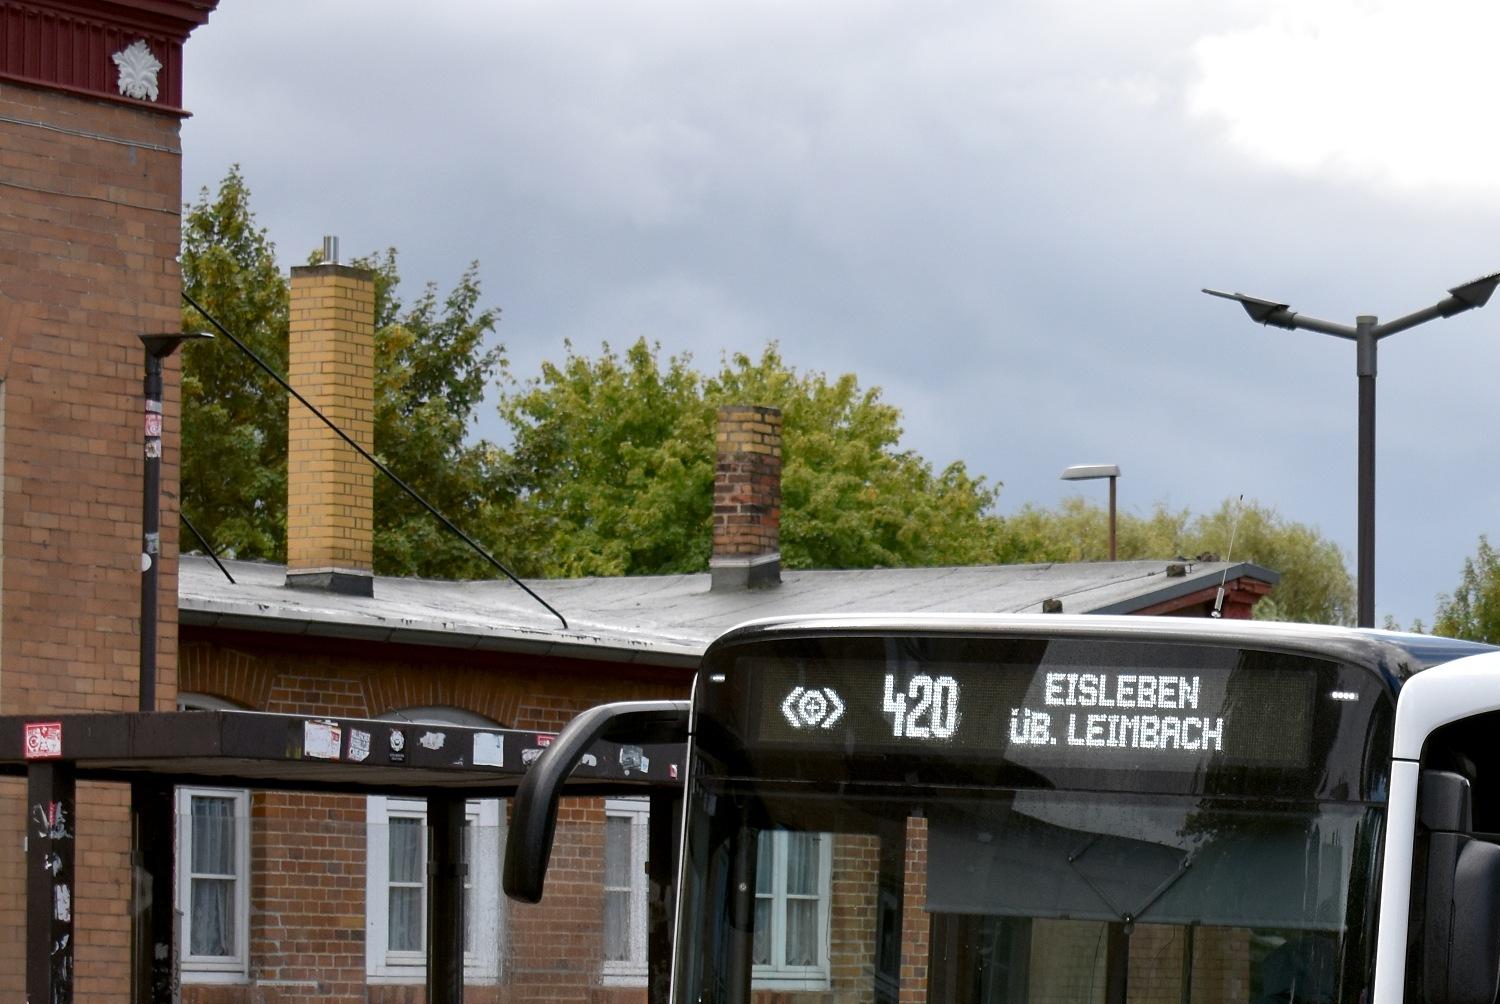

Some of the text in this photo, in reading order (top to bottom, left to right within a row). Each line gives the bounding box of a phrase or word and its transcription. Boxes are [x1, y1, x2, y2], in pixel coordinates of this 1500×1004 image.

[883, 673, 960, 739] 420
[1044, 671, 1200, 710] EISLEBEN
[1008, 707, 1224, 752] ÜB. LEIMBACH
